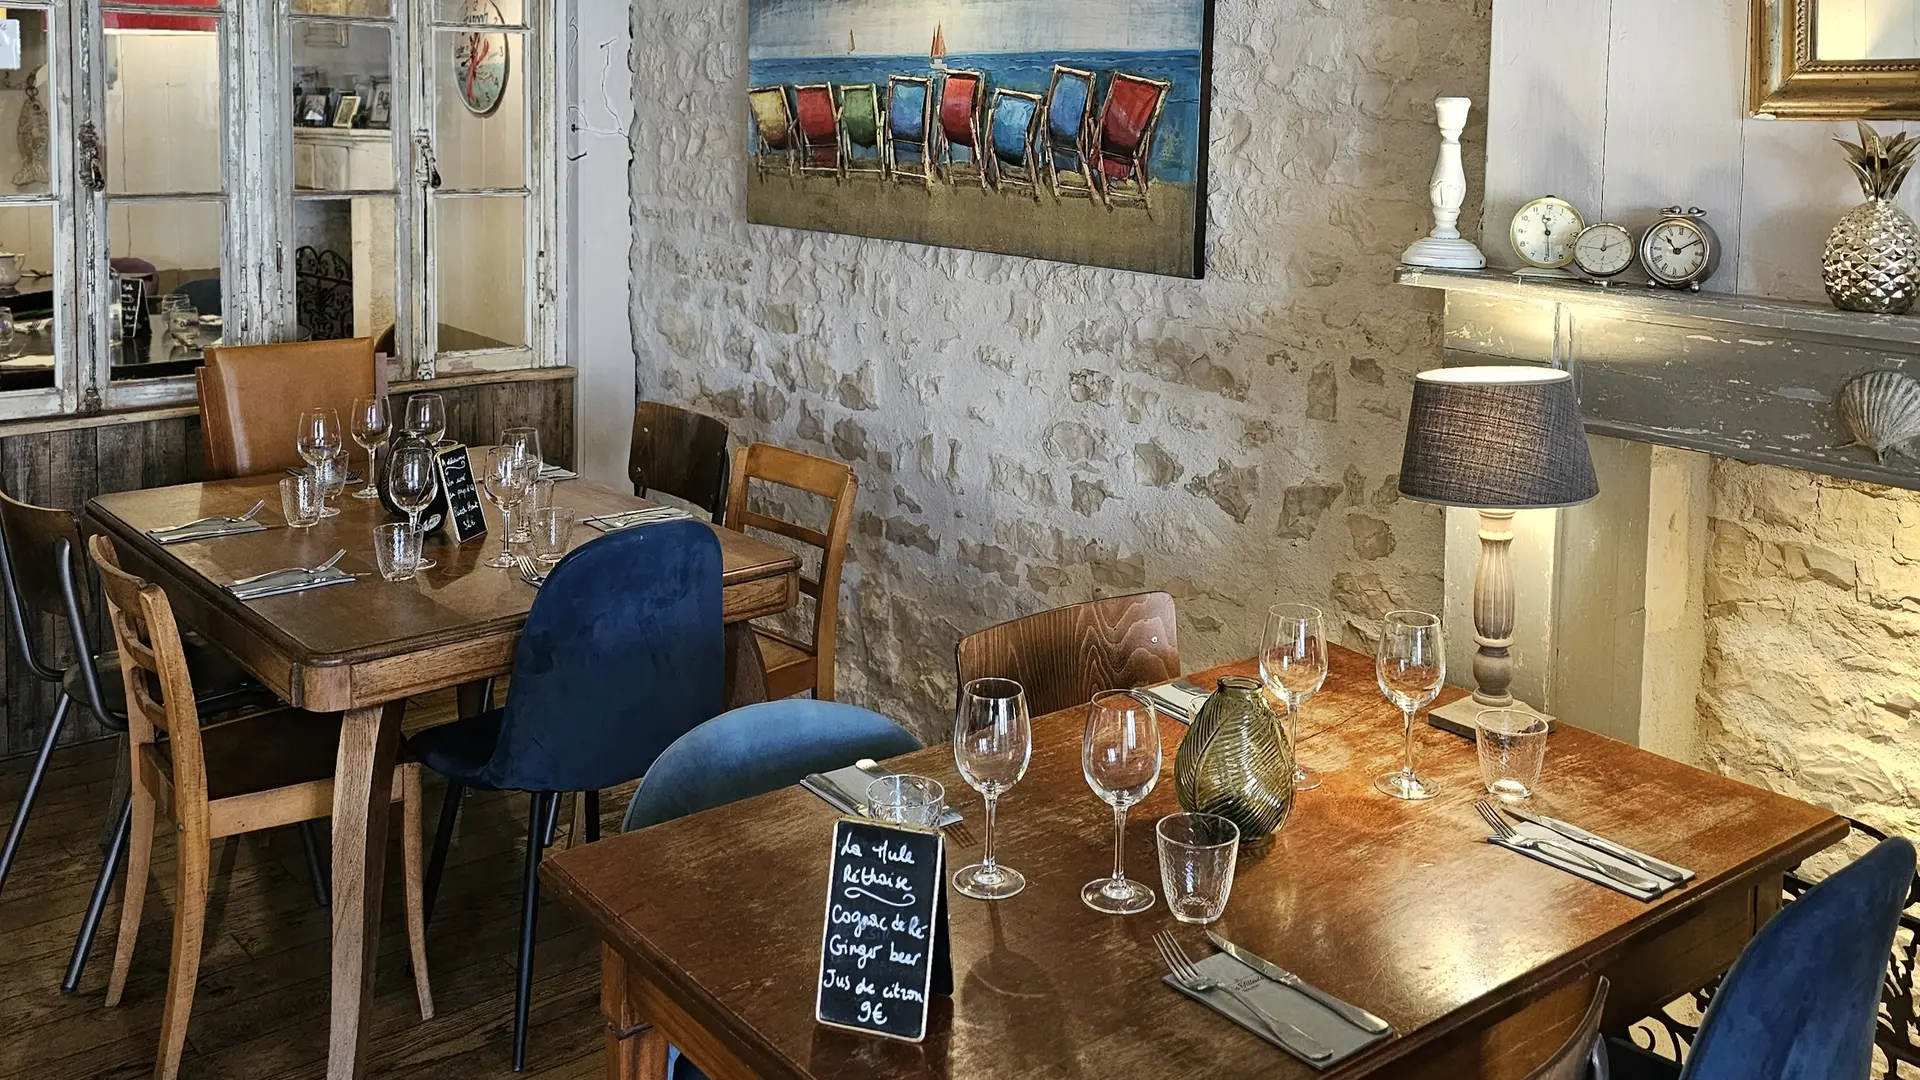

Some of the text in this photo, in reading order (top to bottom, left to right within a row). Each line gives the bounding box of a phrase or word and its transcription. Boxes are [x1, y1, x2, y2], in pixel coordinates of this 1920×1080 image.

[841, 831, 915, 864] La Mule
[832, 904, 929, 939] Cognac de Ré
[829, 934, 922, 969] Ginger beer
[823, 969, 924, 1003] Jus de citron
[857, 1001, 888, 1025] 9€
